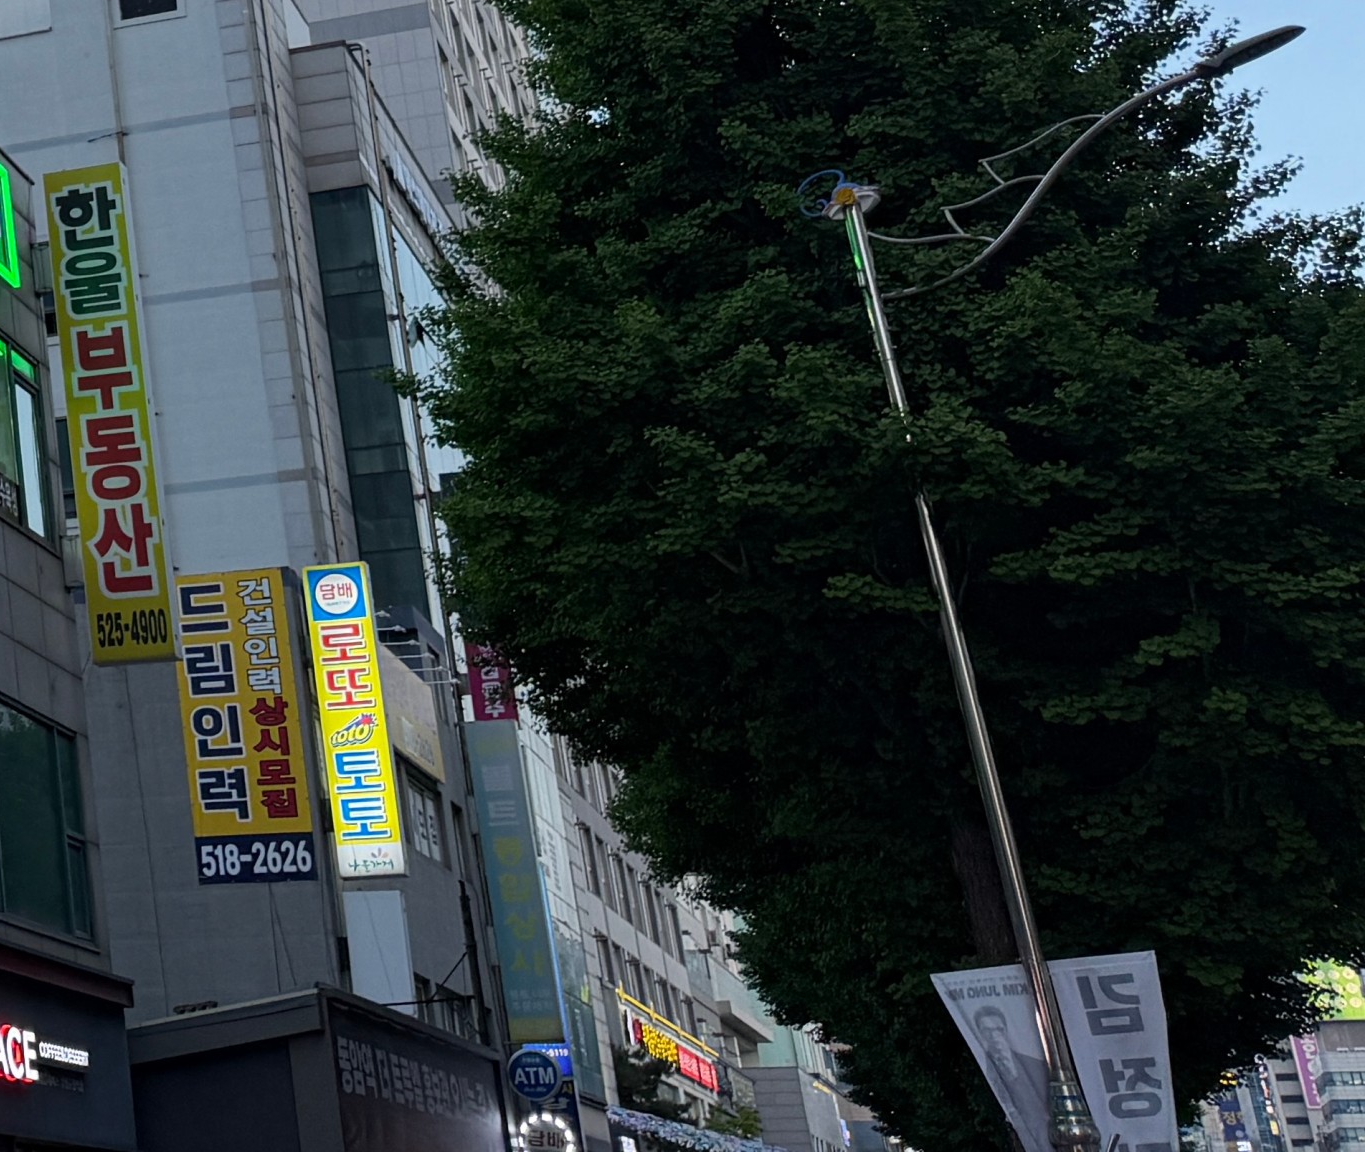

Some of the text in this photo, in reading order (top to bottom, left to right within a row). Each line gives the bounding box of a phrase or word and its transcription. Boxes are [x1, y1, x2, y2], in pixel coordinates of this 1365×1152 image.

[320, 582, 354, 600] 담배
[96, 608, 168, 648] 525-4900
[237, 578, 299, 818] 건설인력 상시모집
[320, 623, 376, 710] 로또
[179, 583, 251, 822] 드림인력
[334, 750, 392, 840] 토토
[201, 840, 313, 878] 518-2626
[514, 1067, 555, 1086] ATM
